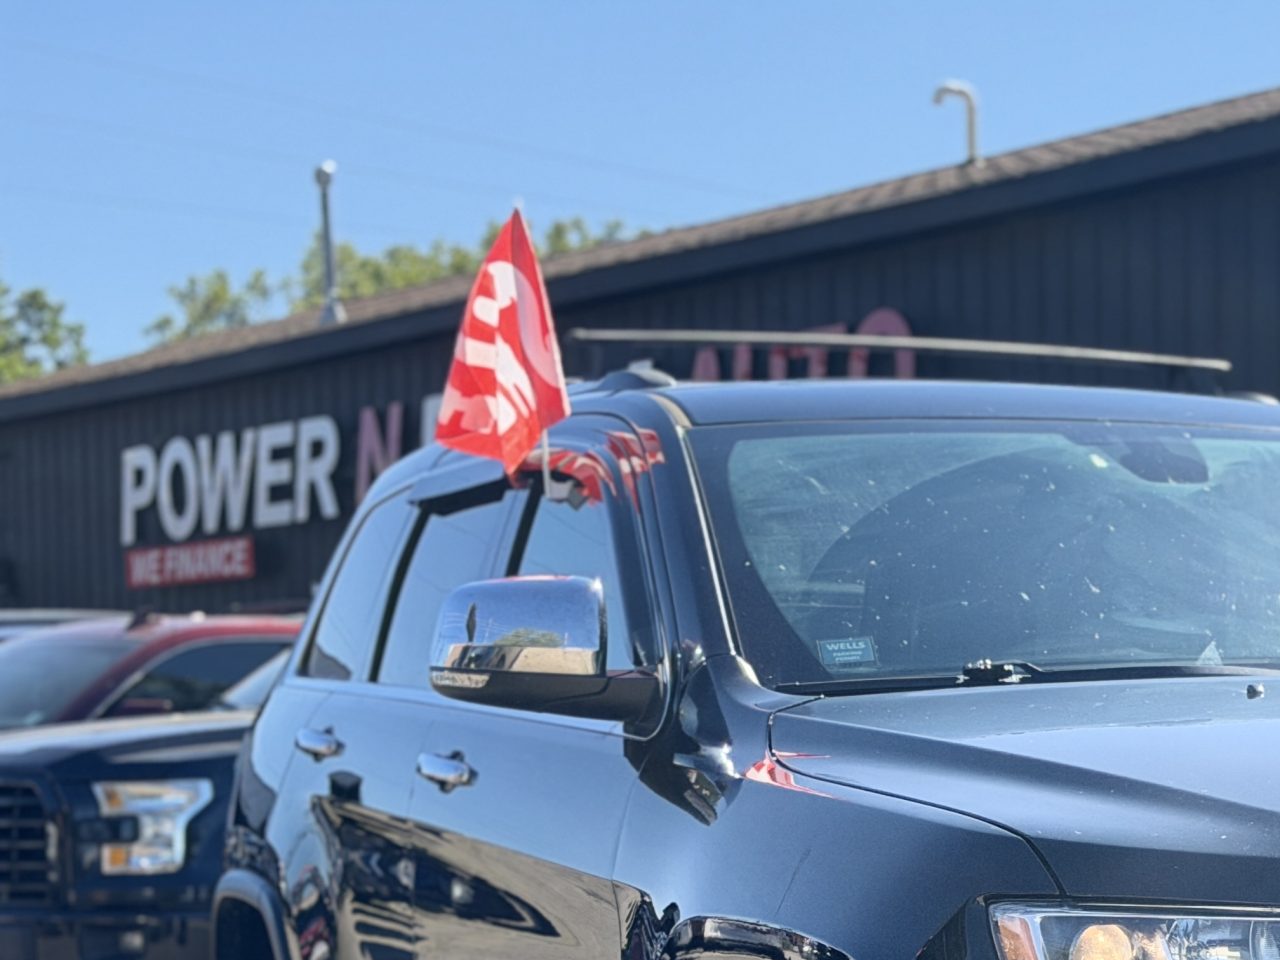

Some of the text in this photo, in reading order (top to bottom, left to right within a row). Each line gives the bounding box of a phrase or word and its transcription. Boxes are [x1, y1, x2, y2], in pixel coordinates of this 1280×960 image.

[120, 414, 341, 547] POWER
[355, 401, 403, 507] N
[826, 641, 866, 651] WELLS
